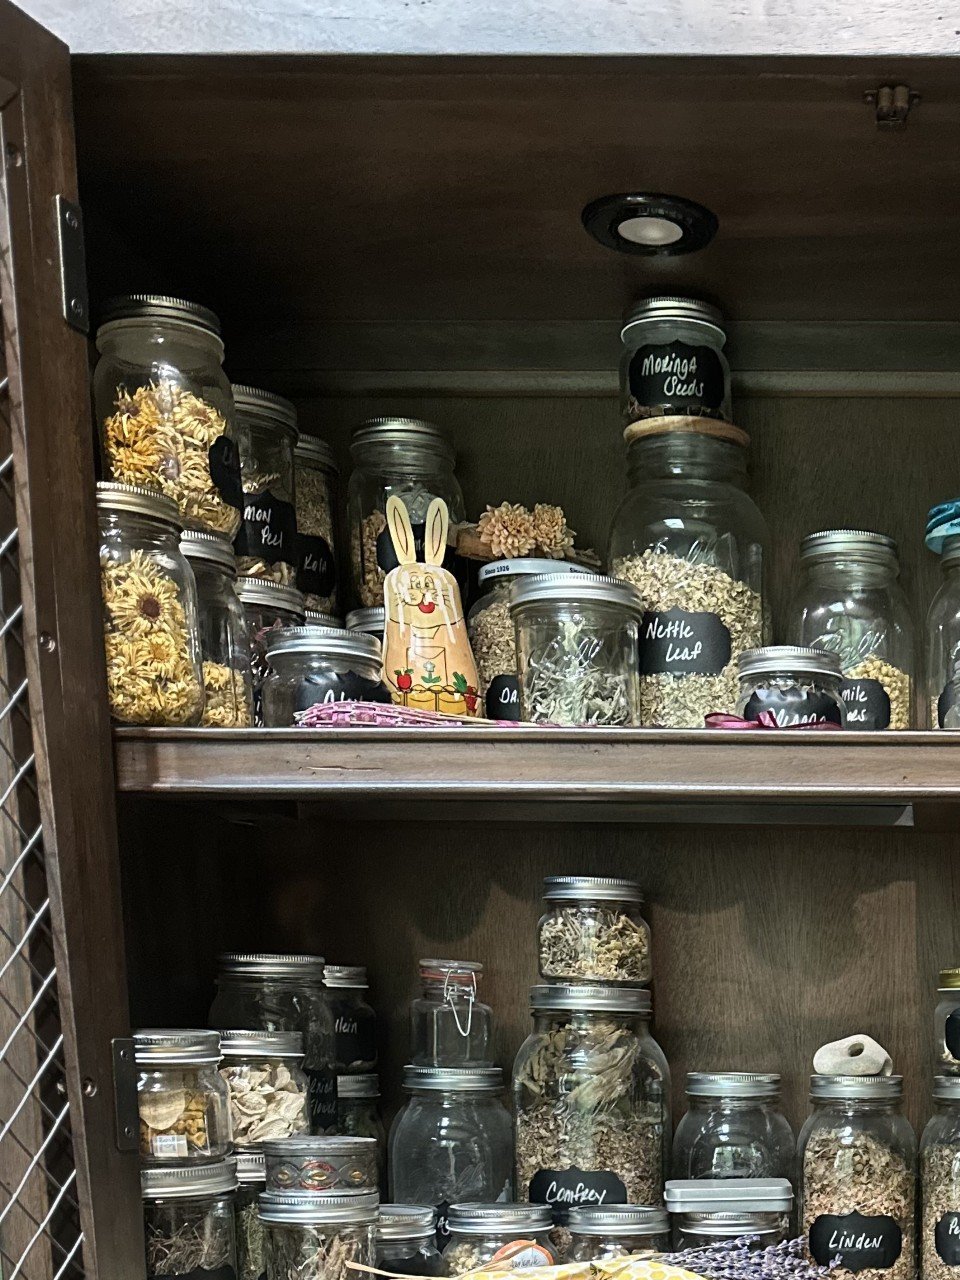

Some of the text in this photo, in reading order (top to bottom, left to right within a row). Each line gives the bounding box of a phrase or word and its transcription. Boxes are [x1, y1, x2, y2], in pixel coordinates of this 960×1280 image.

[663, 376, 704, 397] Seeds
[261, 525, 283, 548] Peel
[646, 618, 694, 639] Nettle
[666, 643, 702, 662] Leaf
